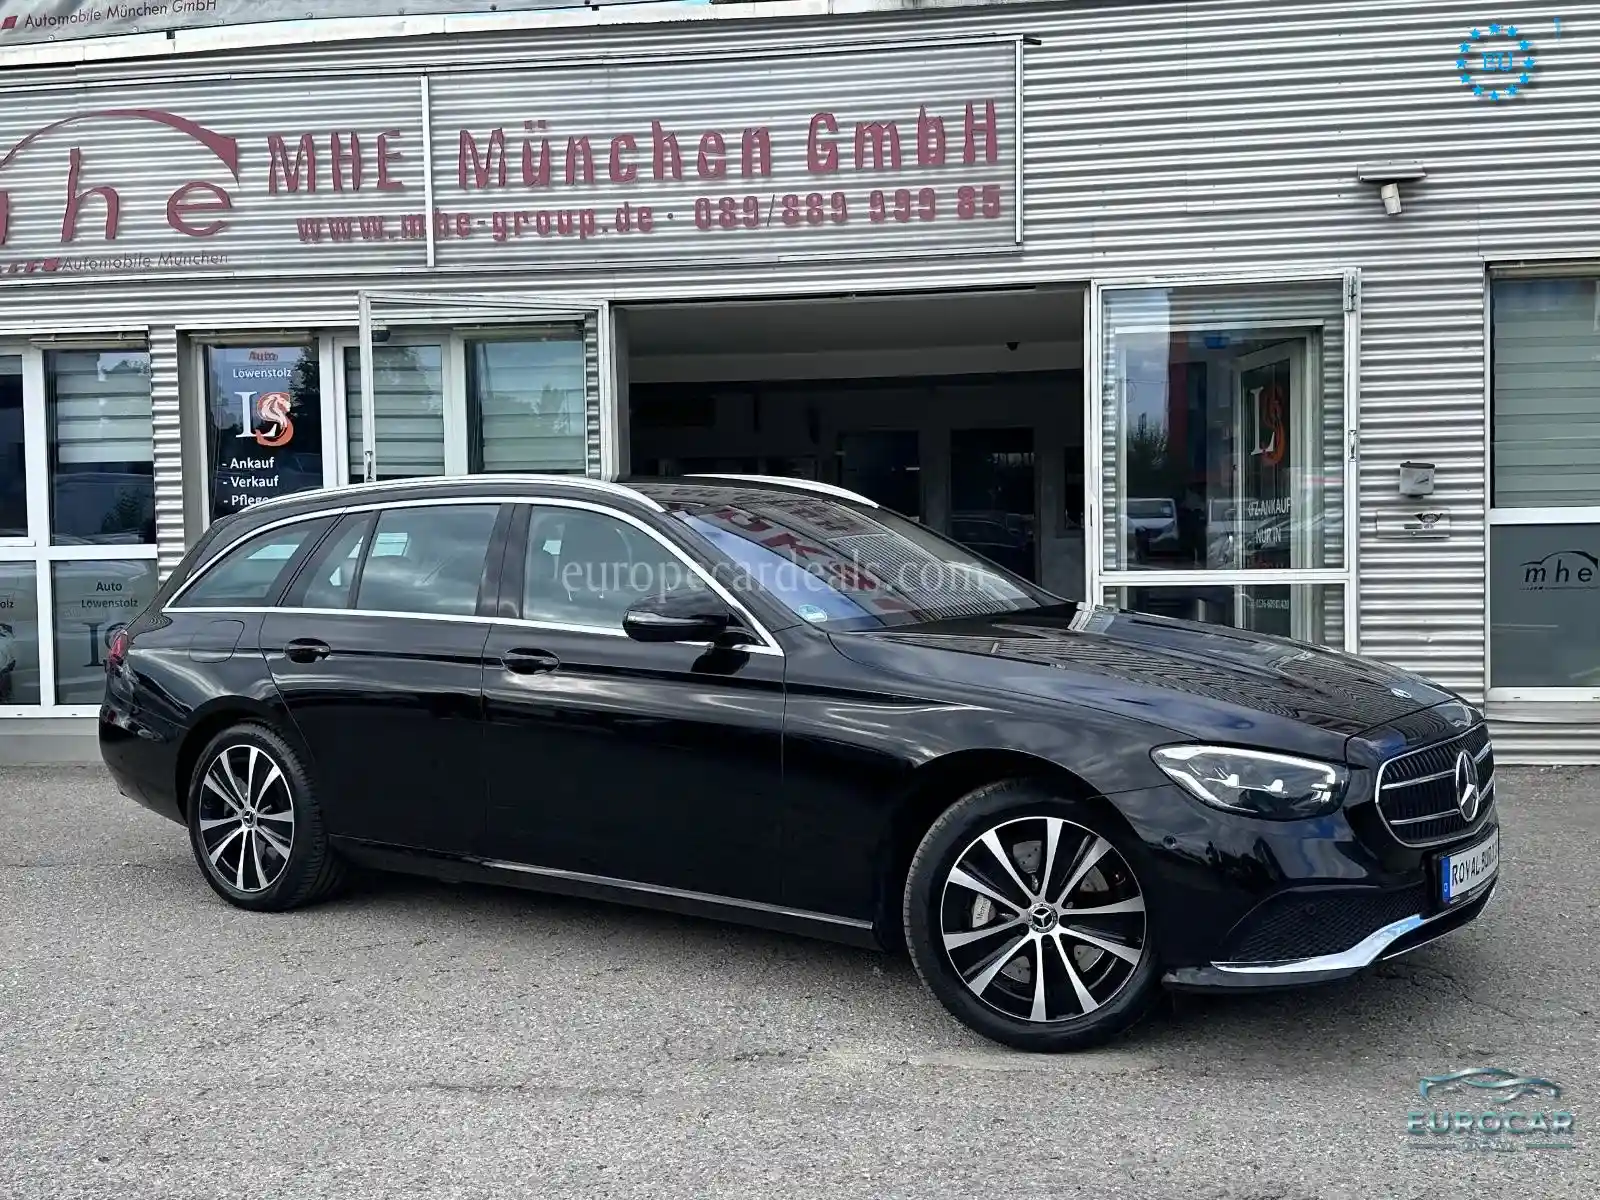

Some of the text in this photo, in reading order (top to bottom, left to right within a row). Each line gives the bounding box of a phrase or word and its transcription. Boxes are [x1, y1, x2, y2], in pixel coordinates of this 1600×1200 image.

[25, 0, 216, 28] Automobile München GmbH
[267, 98, 998, 195] MHE München GmbH
[0, 147, 232, 244] he
[296, 184, 1001, 243] www.mhe-group.de 089/889 999 85
[62, 251, 228, 271] Automobile München
[230, 457, 275, 469] Ankauf
[231, 476, 279, 488] Verkauf
[1525, 558, 1593, 582] mhe
[95, 581, 123, 592] Auto
[1452, 855, 1479, 887] ROYAL
